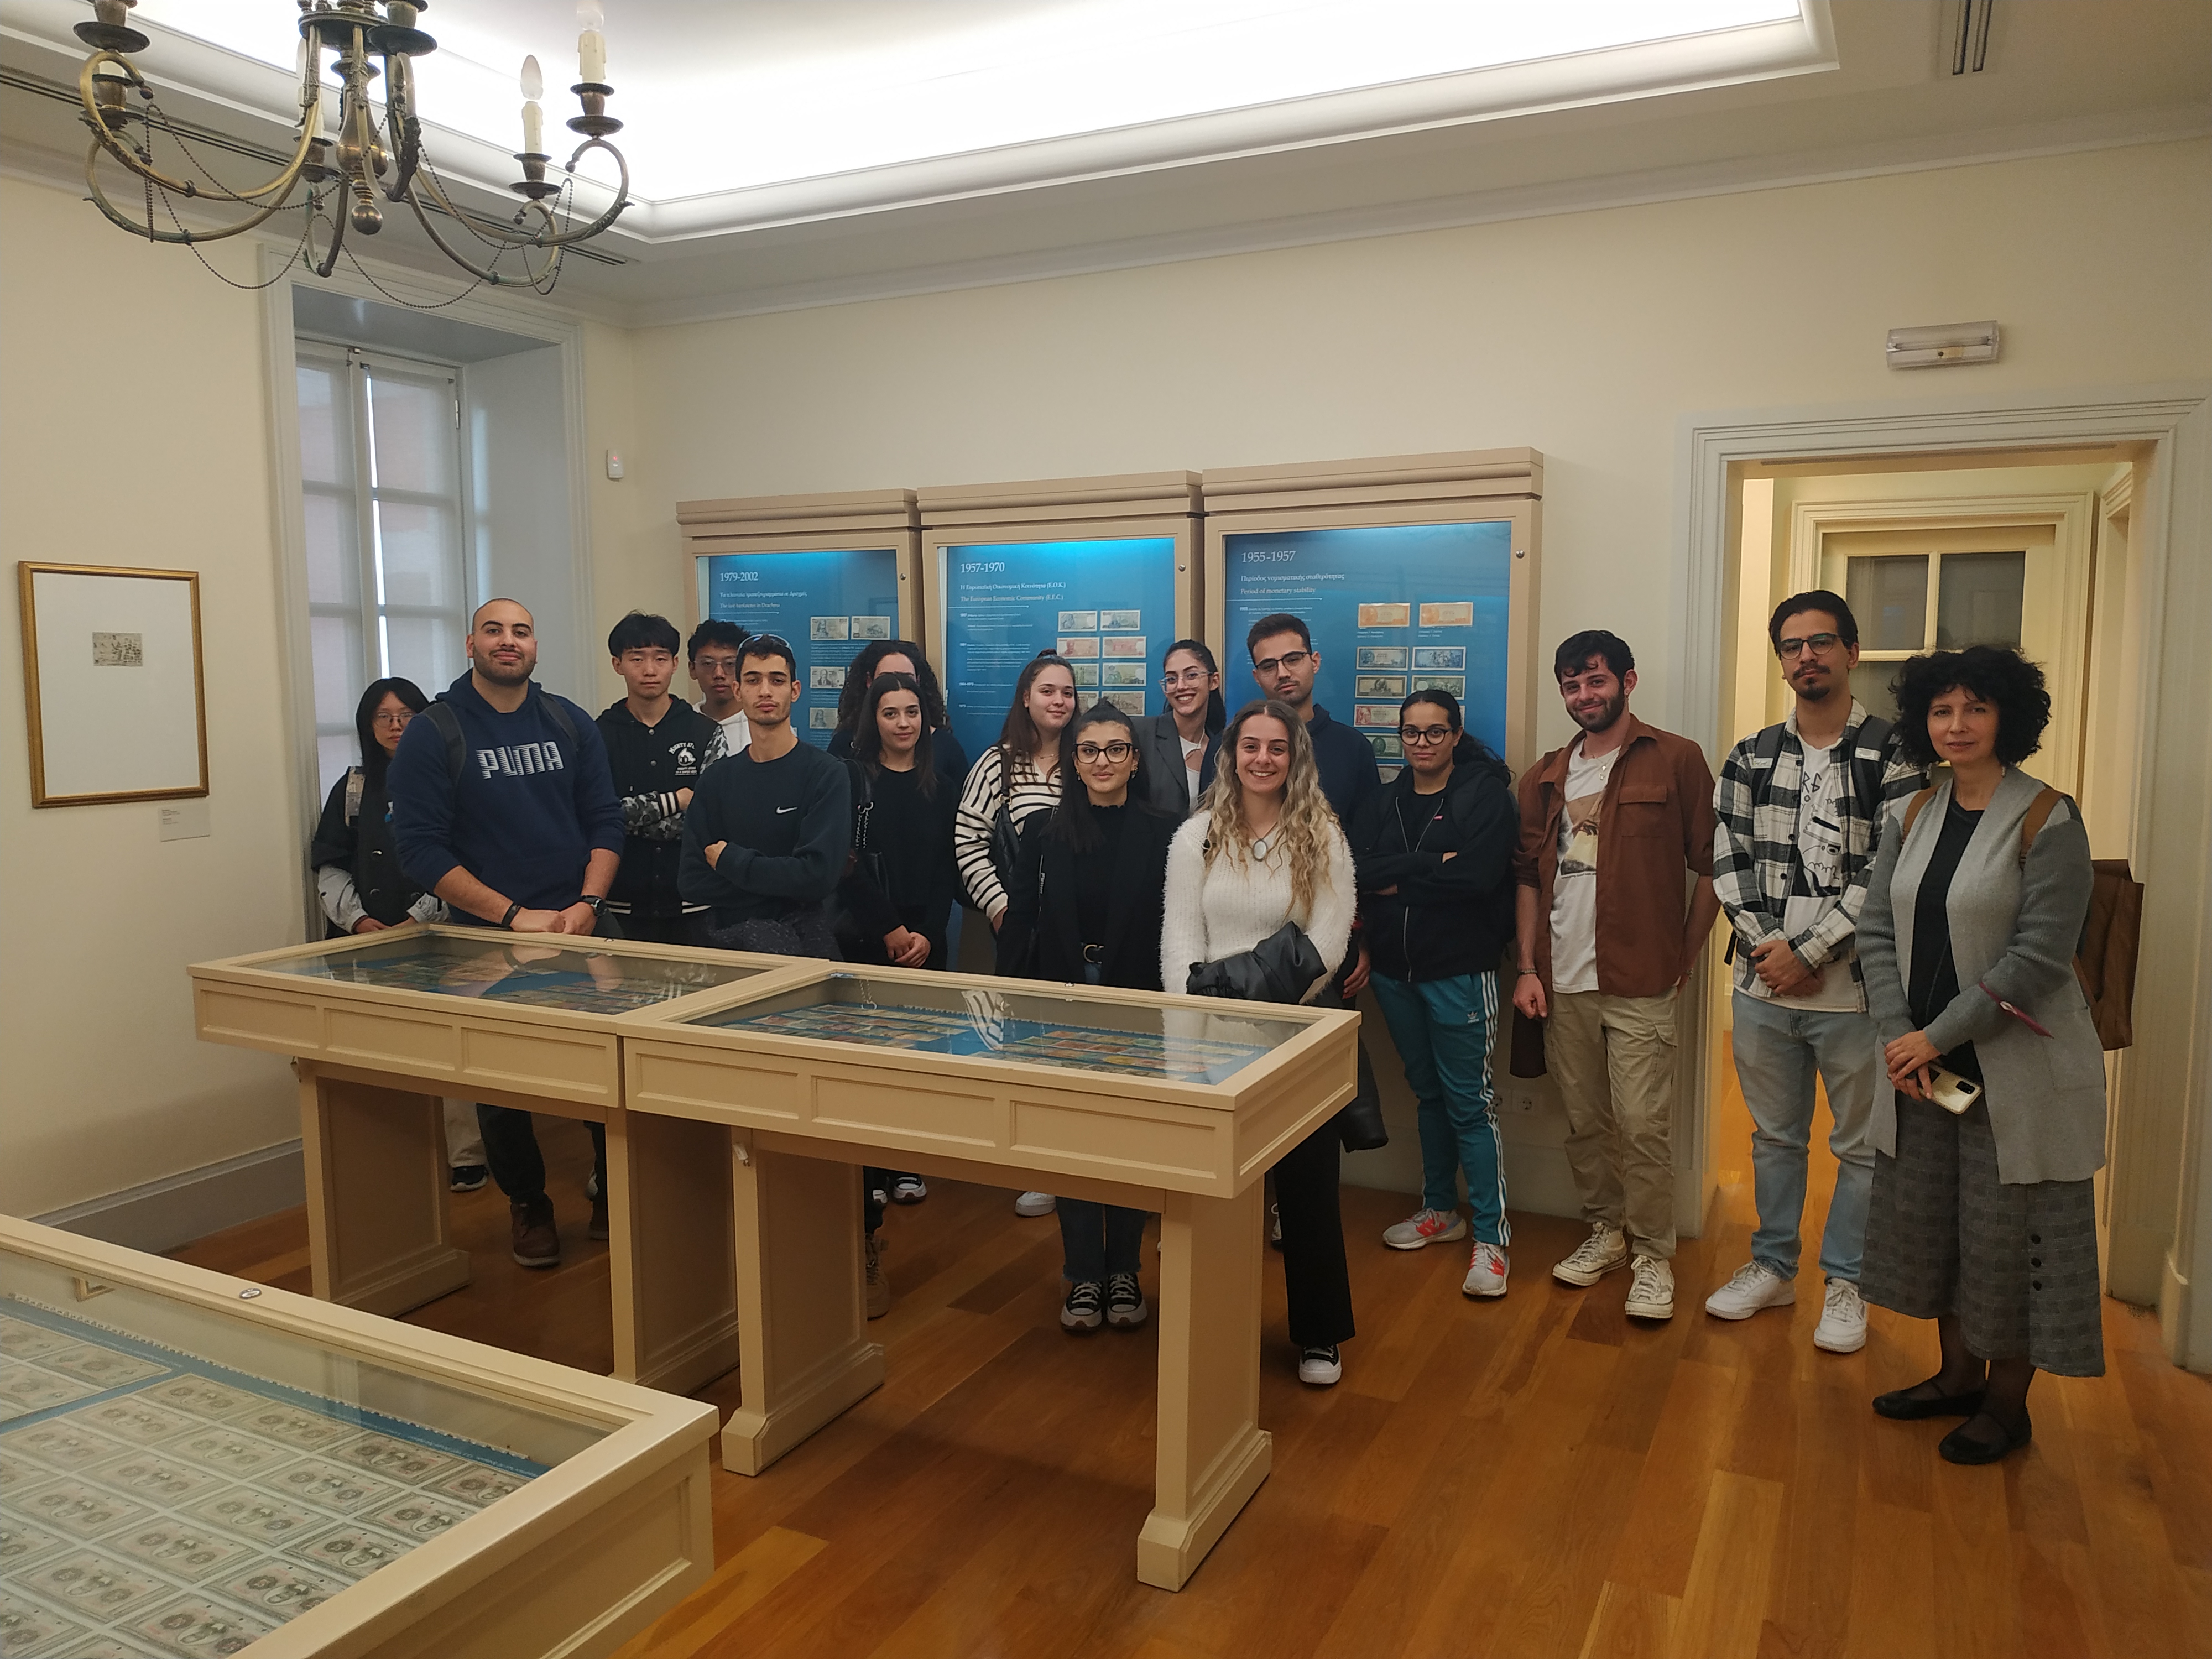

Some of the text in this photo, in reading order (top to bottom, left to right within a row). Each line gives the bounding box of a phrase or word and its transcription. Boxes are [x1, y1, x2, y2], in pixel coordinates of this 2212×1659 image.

[1241, 550, 1296, 562] 1955-1957
[961, 562, 1005, 573] 1957-1970
[720, 572, 758, 581] 1979-2002
[476, 741, 565, 780] PUMA
